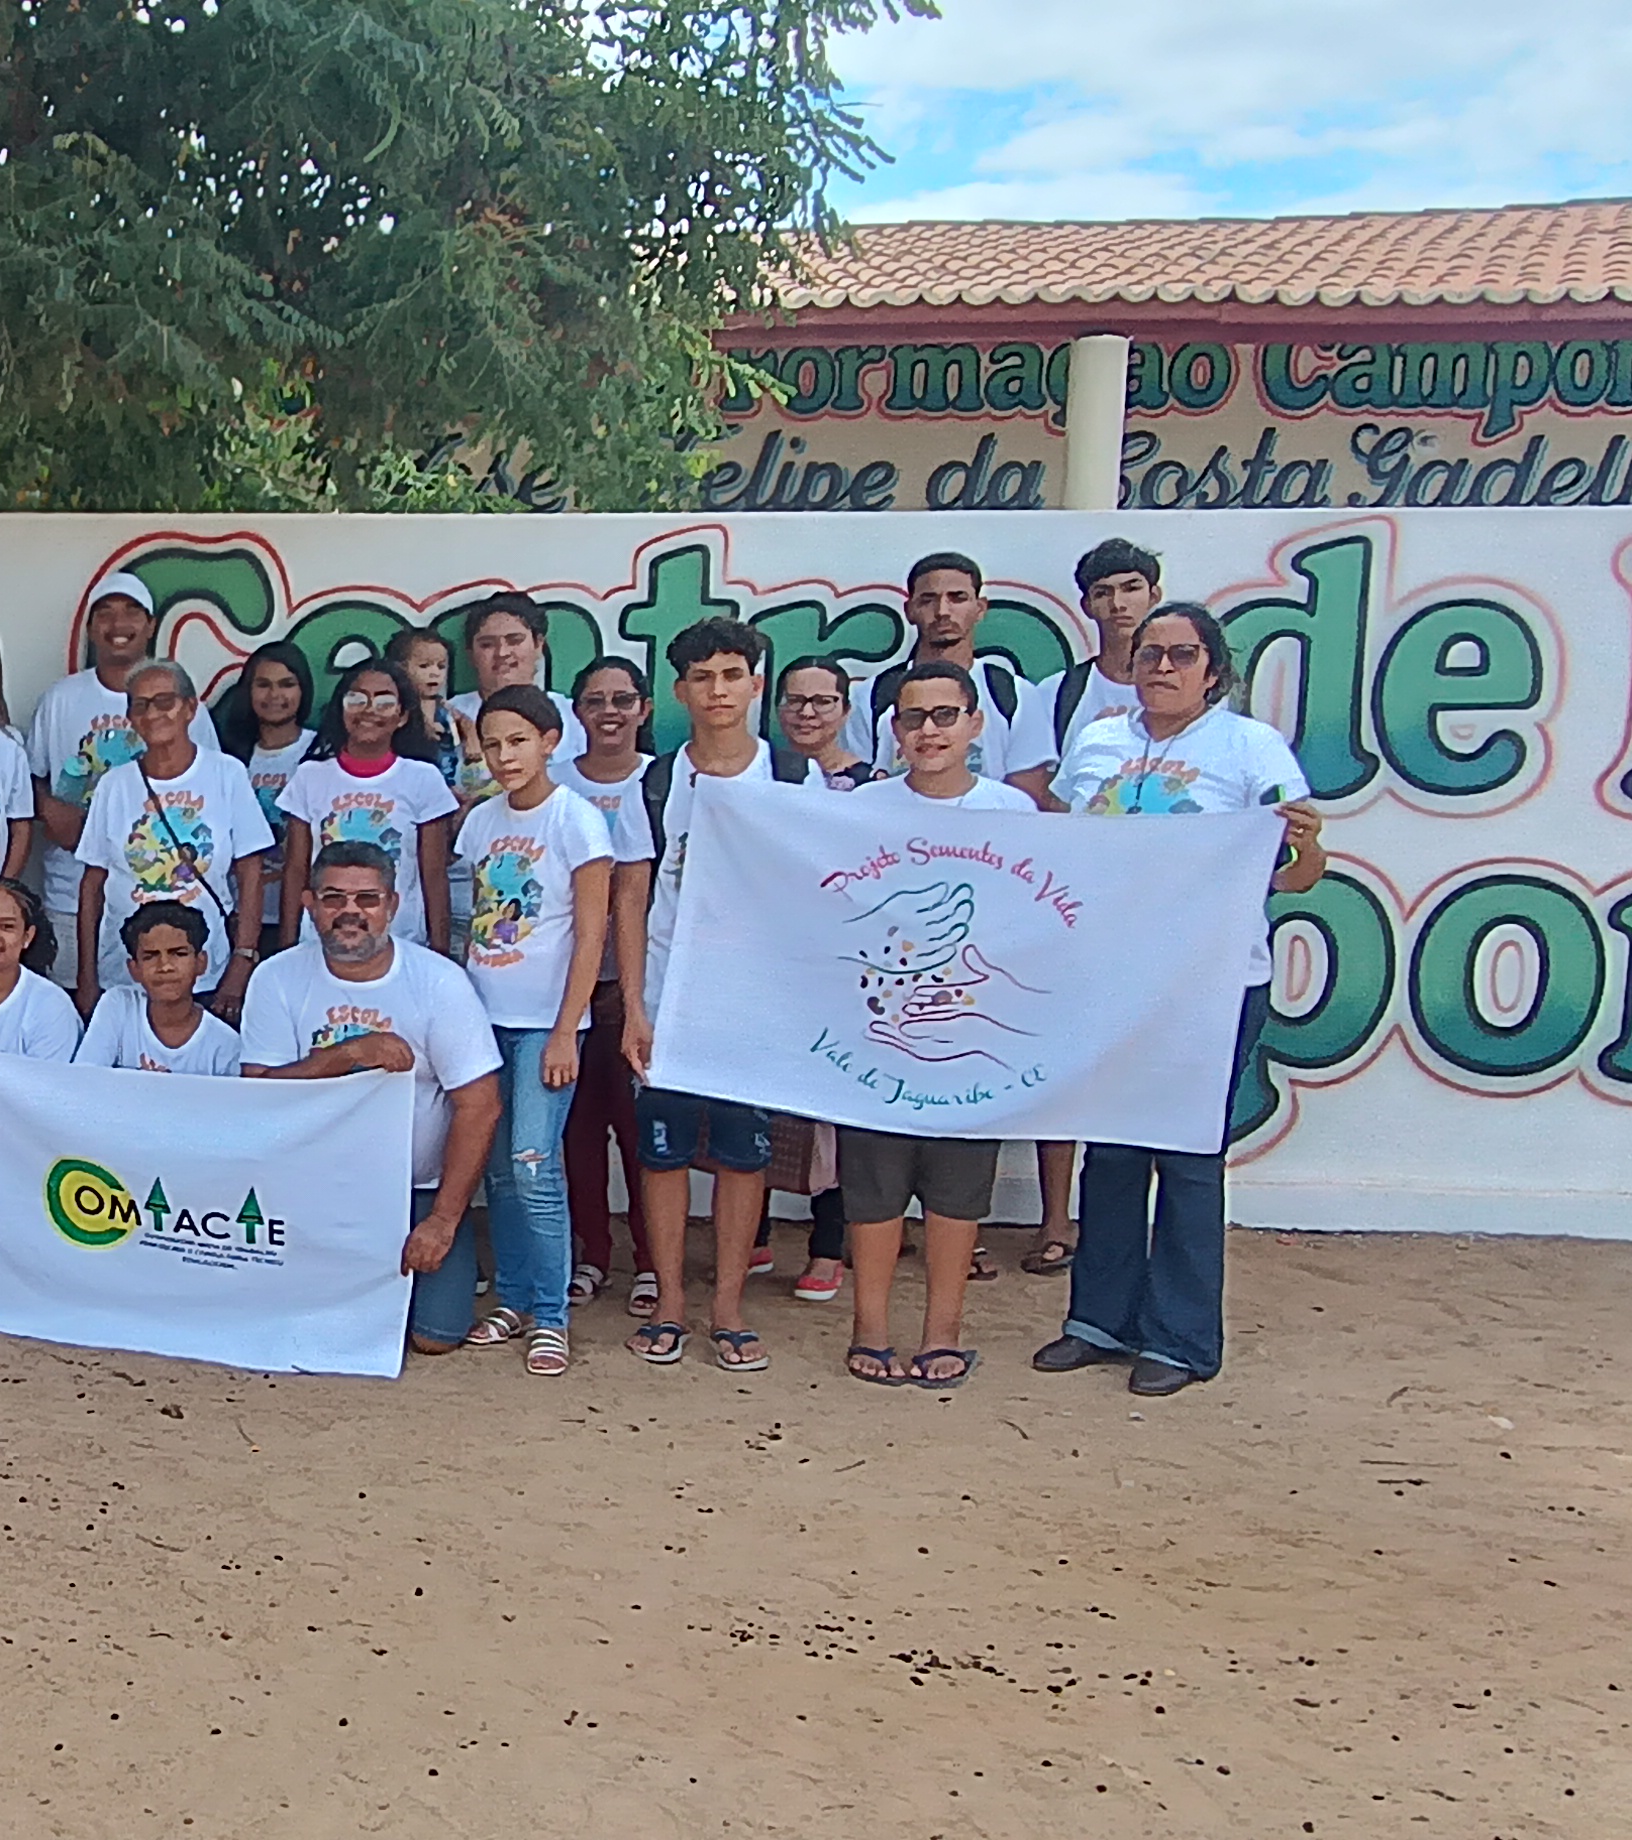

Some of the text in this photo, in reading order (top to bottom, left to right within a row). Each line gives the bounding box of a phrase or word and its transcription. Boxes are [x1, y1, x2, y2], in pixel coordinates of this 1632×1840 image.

[1264, 342, 1632, 437] Campo
[925, 432, 1046, 511] da
[1350, 422, 1632, 510] Gadel
[1218, 537, 1545, 800] de
[143, 790, 205, 813] ECOLA
[331, 791, 395, 814] ESCOLA
[820, 837, 1084, 929] Projeto Sementes da Vida
[325, 1005, 393, 1032] ESCOLA
[810, 1027, 853, 1073] Vale
[858, 1067, 879, 1090] de
[883, 1073, 994, 1110] Jaguaribe
